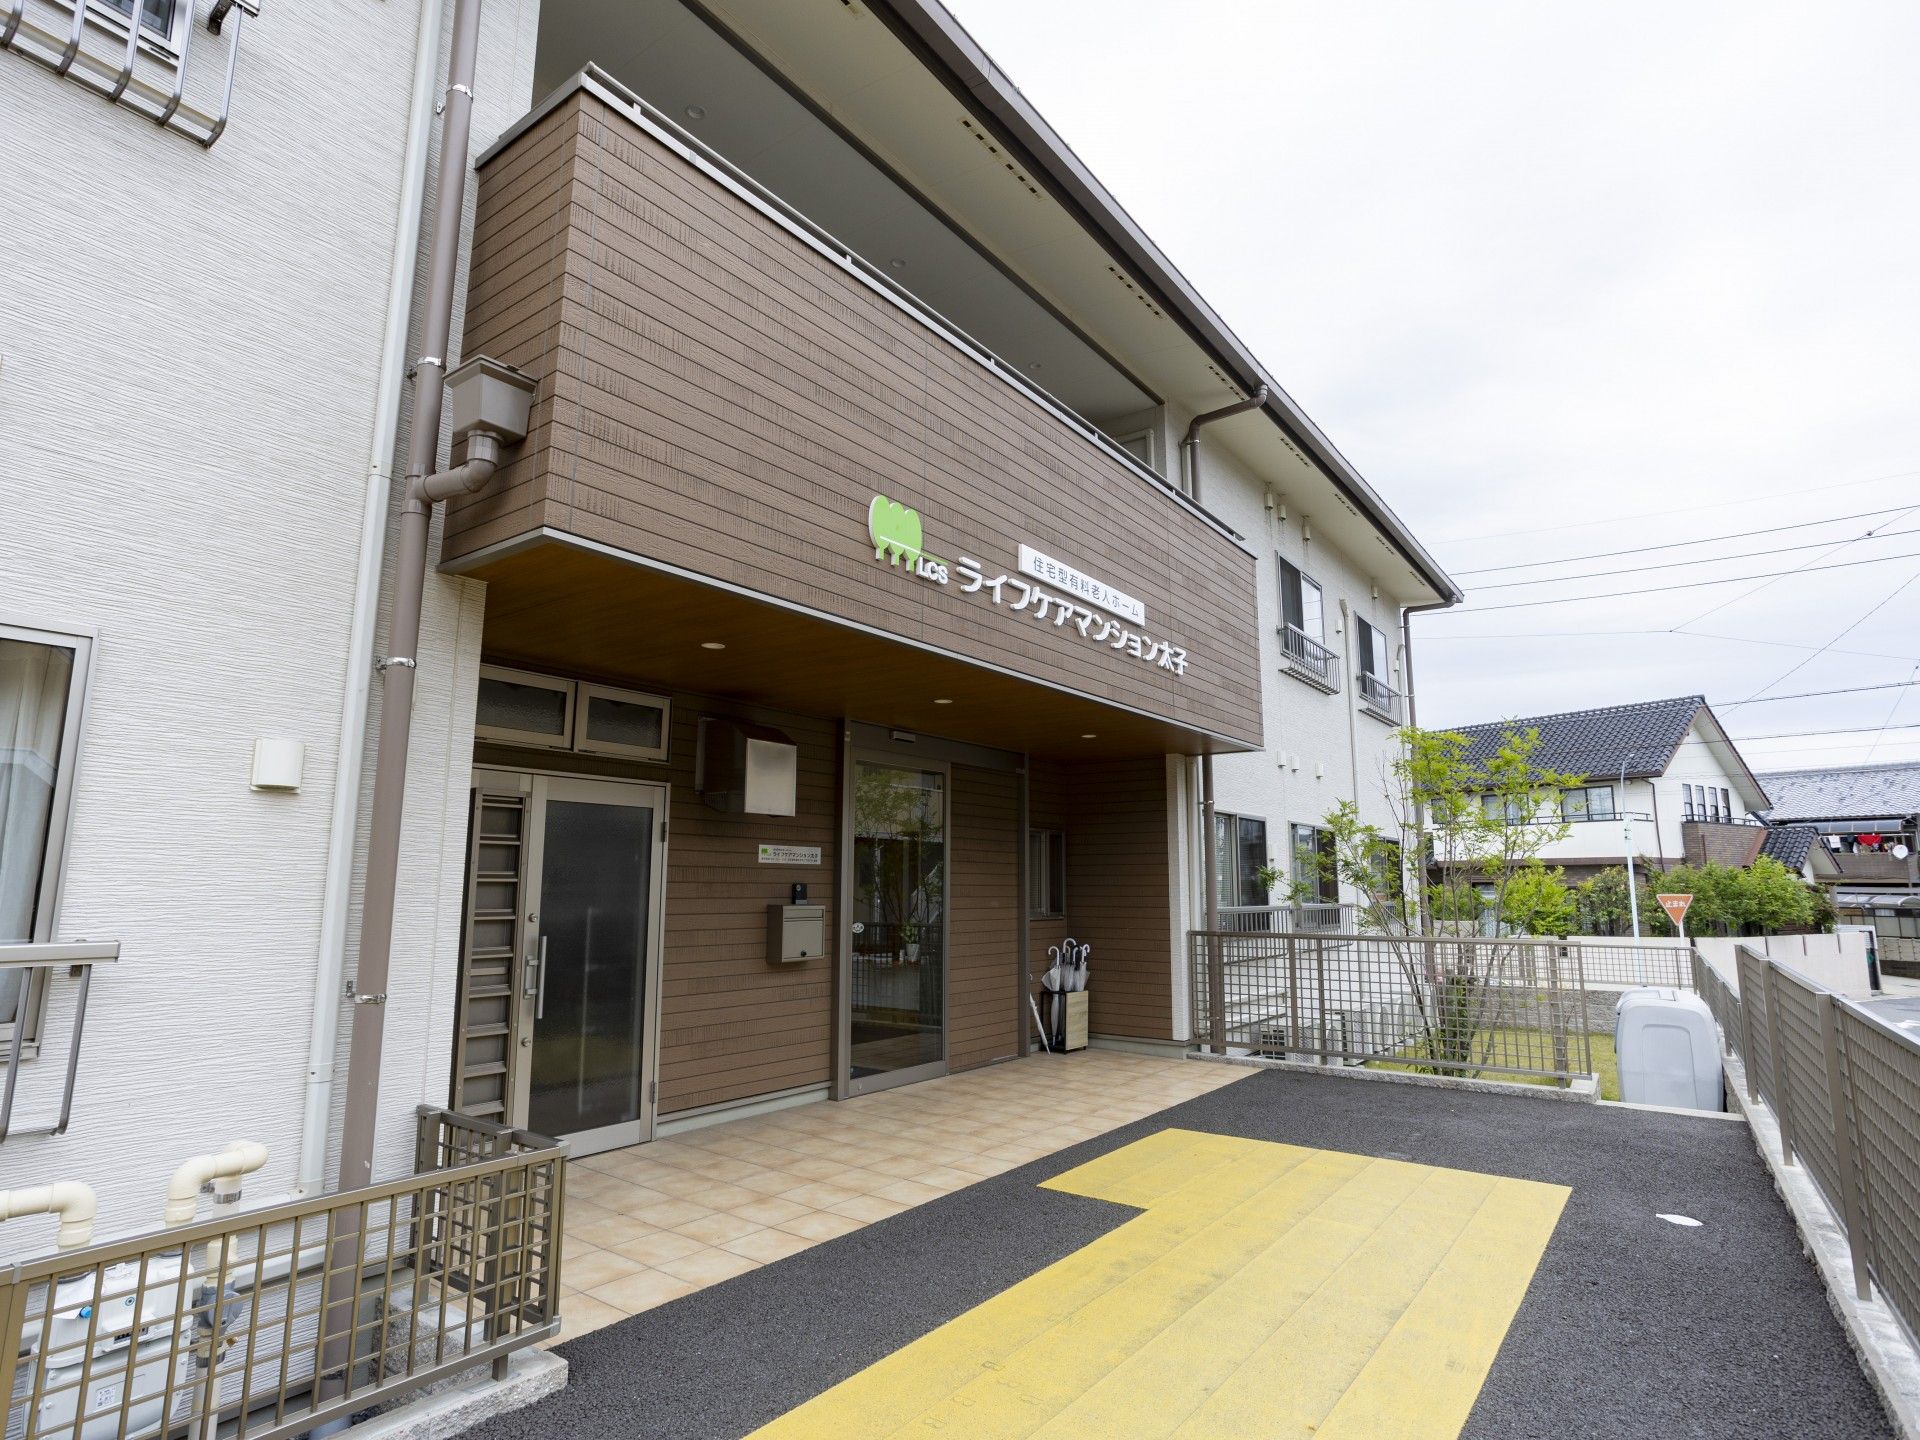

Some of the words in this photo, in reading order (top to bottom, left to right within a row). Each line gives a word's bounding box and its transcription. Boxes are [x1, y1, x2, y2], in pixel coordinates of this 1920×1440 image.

[916, 556, 948, 585] LCS
[1033, 556, 1139, 617] 住宅型有料老人ホーム
[956, 556, 1189, 676] ライフケアマンション太子
[1665, 900, 1687, 908] 止まれ
